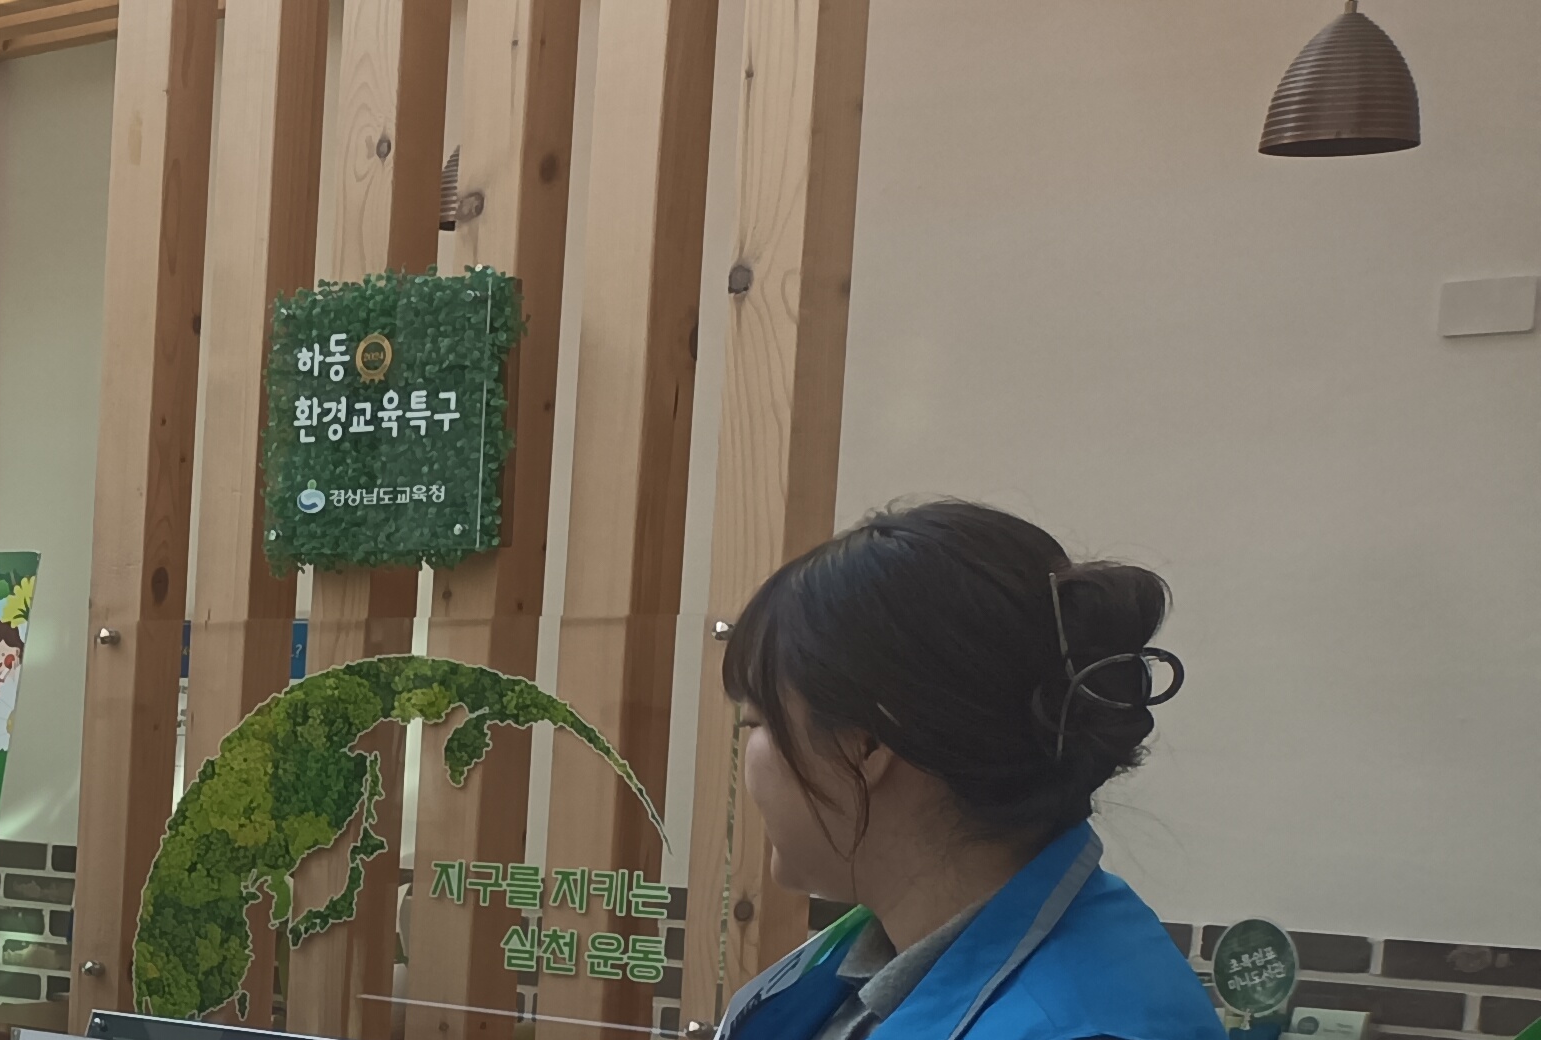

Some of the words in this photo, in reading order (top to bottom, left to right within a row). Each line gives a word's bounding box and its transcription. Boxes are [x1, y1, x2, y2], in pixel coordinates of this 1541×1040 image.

[297, 333, 350, 381] 하동
[293, 390, 460, 443] 환경교육특구
[329, 485, 445, 506] 경상남도교육청
[430, 859, 543, 910] 지구를
[549, 867, 671, 918] 지키는
[501, 925, 577, 975] 실천
[584, 931, 667, 984] 운동
